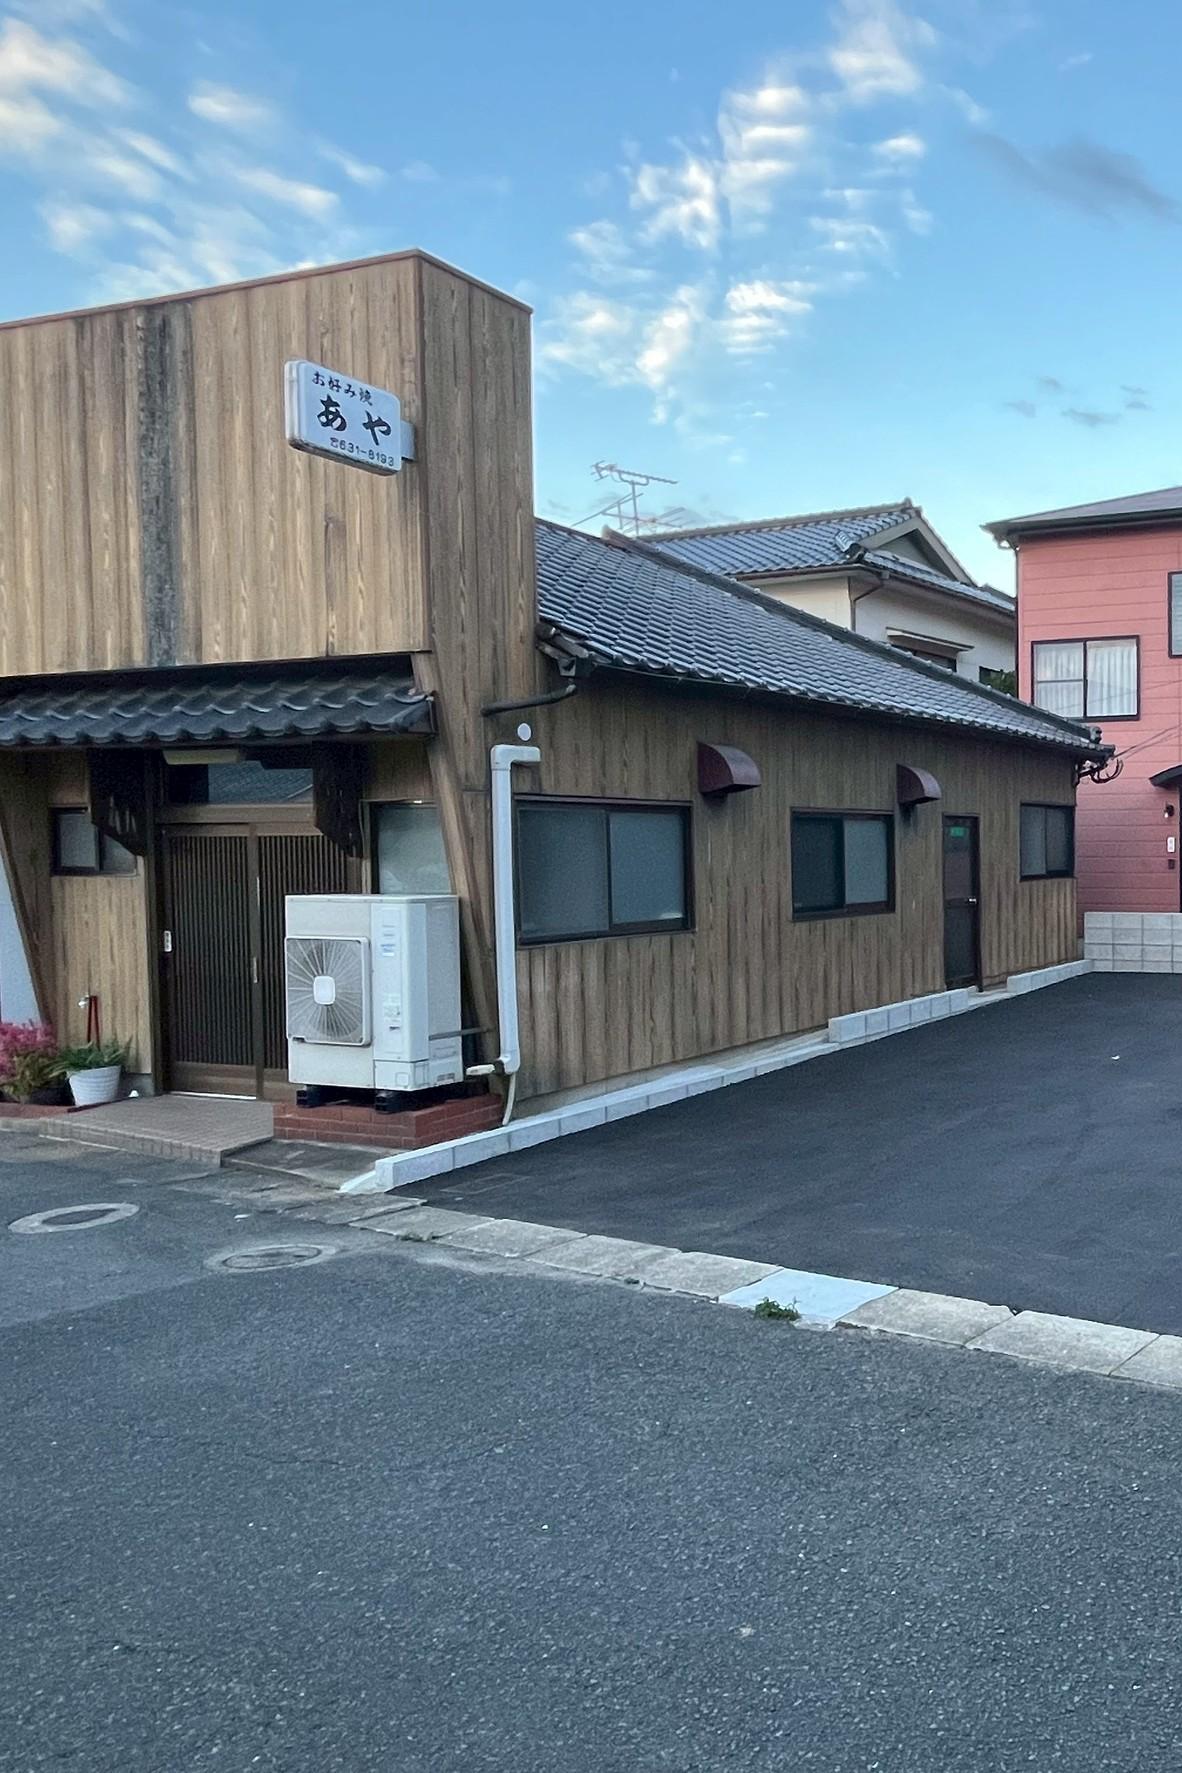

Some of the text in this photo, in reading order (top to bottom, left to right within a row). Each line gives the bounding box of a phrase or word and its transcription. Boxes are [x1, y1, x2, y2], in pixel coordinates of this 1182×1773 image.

[312, 371, 373, 406] お好み焼
[317, 394, 391, 446] あや
